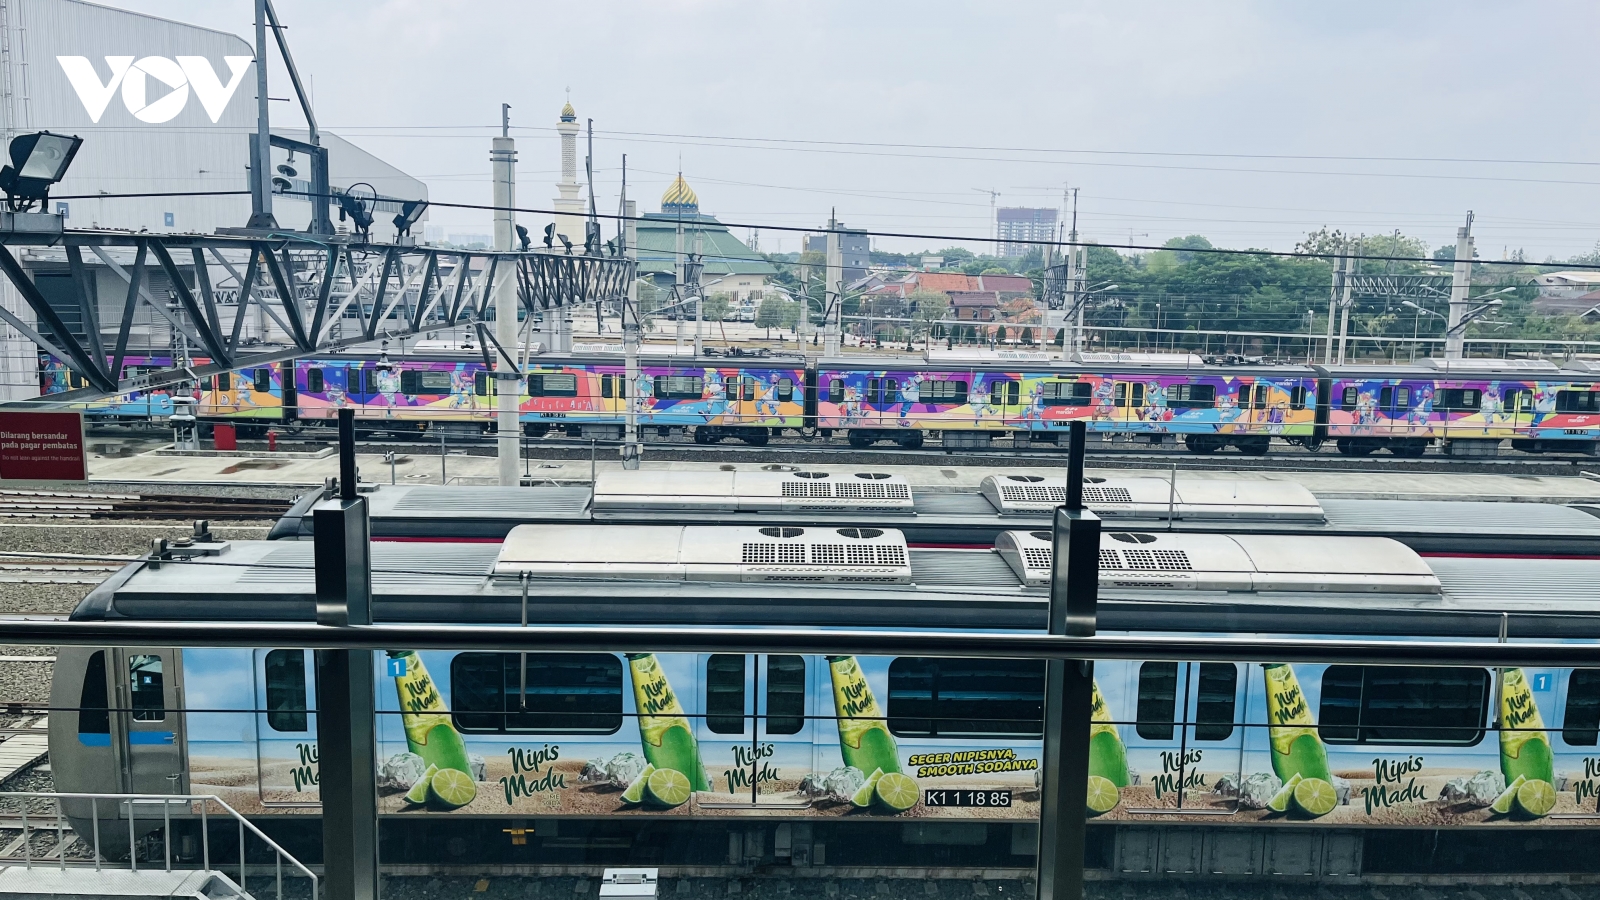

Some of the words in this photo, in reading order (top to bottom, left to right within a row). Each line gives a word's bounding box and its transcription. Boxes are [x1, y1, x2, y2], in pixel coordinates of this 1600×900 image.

[0, 431, 30, 440] Dilarang
[31, 432, 68, 440] bersandar
[1, 441, 19, 450] pada
[20, 442, 41, 451] pagar
[42, 442, 78, 451] pembatas
[393, 661, 399, 675] 1
[404, 674, 430, 699] Nipis
[641, 676, 667, 700] Nipis
[841, 678, 866, 702] Nipis
[1539, 676, 1546, 690] 1
[407, 686, 439, 717] Madu
[643, 688, 675, 719] Madu
[843, 690, 874, 721] Madu
[1274, 685, 1300, 708] Nipis
[1505, 689, 1531, 712] Nipis
[1275, 697, 1308, 726] Madu
[1505, 701, 1538, 729] Madu
[508, 744, 559, 774] Nipis
[908, 753, 951, 766] SEGER
[952, 748, 1018, 763] NIPISNYA,
[917, 763, 975, 778] SMOOTH
[975, 758, 1038, 773] SODANYA
[1372, 755, 1424, 785] Nipis
[500, 766, 569, 806] Madu
[1361, 776, 1429, 816] Madu
[927, 791, 947, 805] K1
[953, 791, 960, 805] 1
[968, 791, 986, 805] 18
[990, 791, 1009, 806] 85
